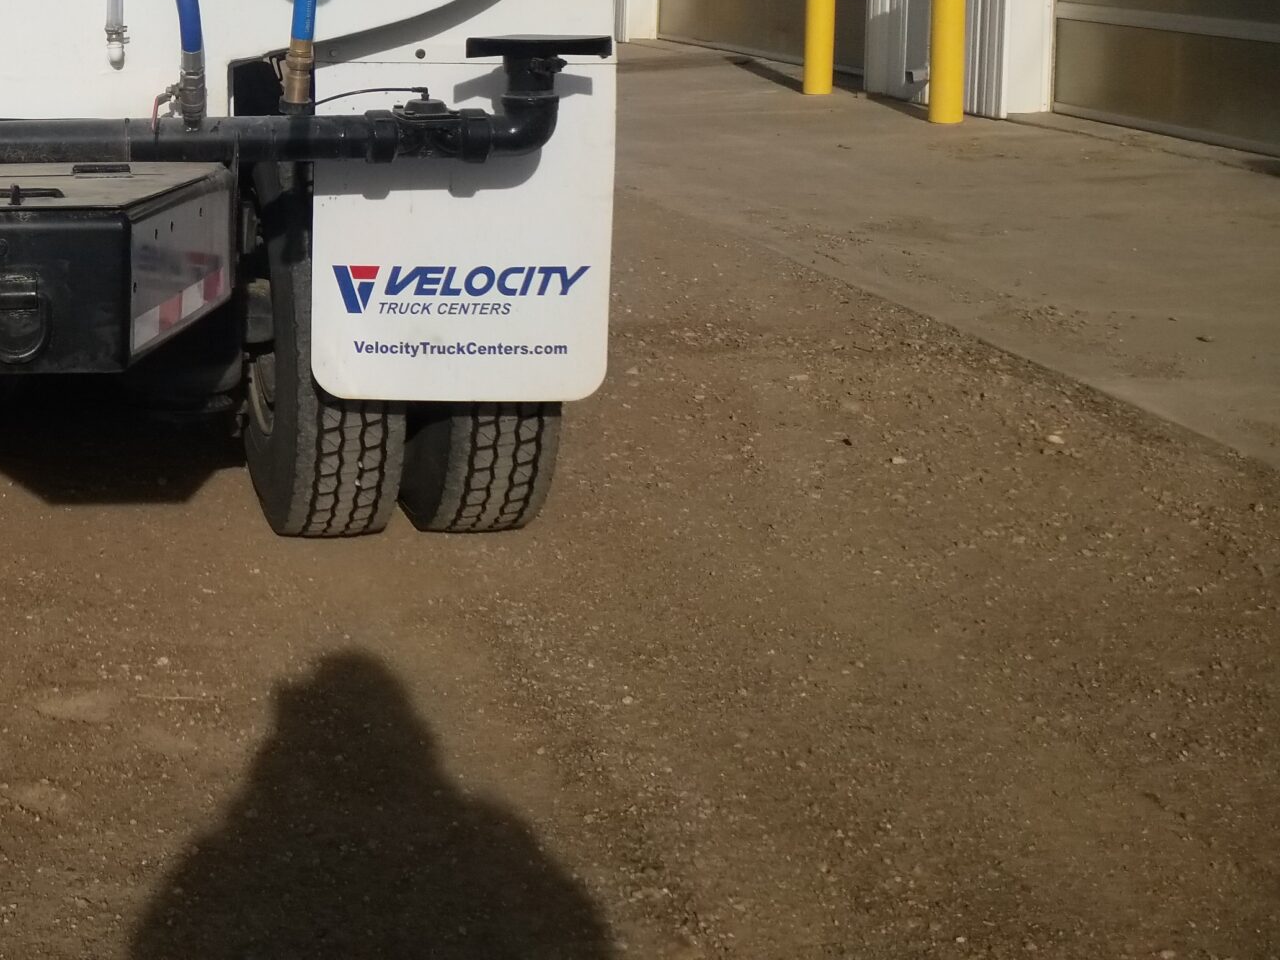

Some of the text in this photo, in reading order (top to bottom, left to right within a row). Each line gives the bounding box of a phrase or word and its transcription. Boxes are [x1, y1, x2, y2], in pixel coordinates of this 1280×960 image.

[384, 265, 592, 297] VELOCITY
[378, 302, 512, 316] TRUCK CENTERS
[353, 340, 568, 358] VelocityTruckCenters.com
